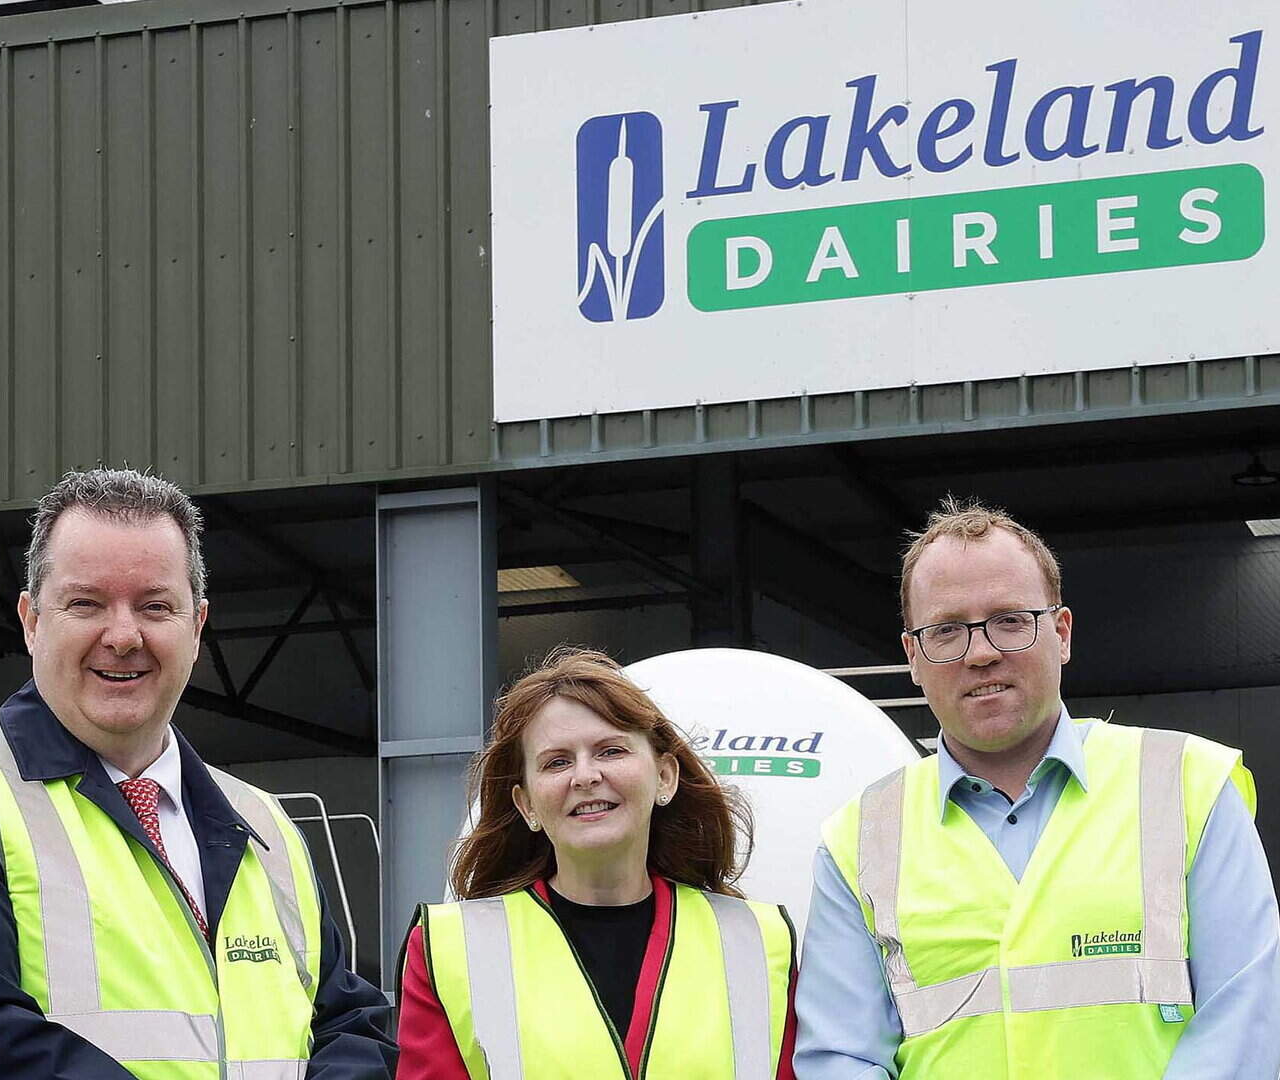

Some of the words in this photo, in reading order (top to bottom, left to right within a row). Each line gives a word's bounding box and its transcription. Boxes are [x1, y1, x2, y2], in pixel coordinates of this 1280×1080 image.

[686, 30, 1265, 199] Lakeland
[725, 187, 1222, 291] DAIRIES
[691, 729, 824, 754] eland
[1084, 930, 1141, 944] Lakeland
[1088, 945, 1140, 954] DAIRIES
